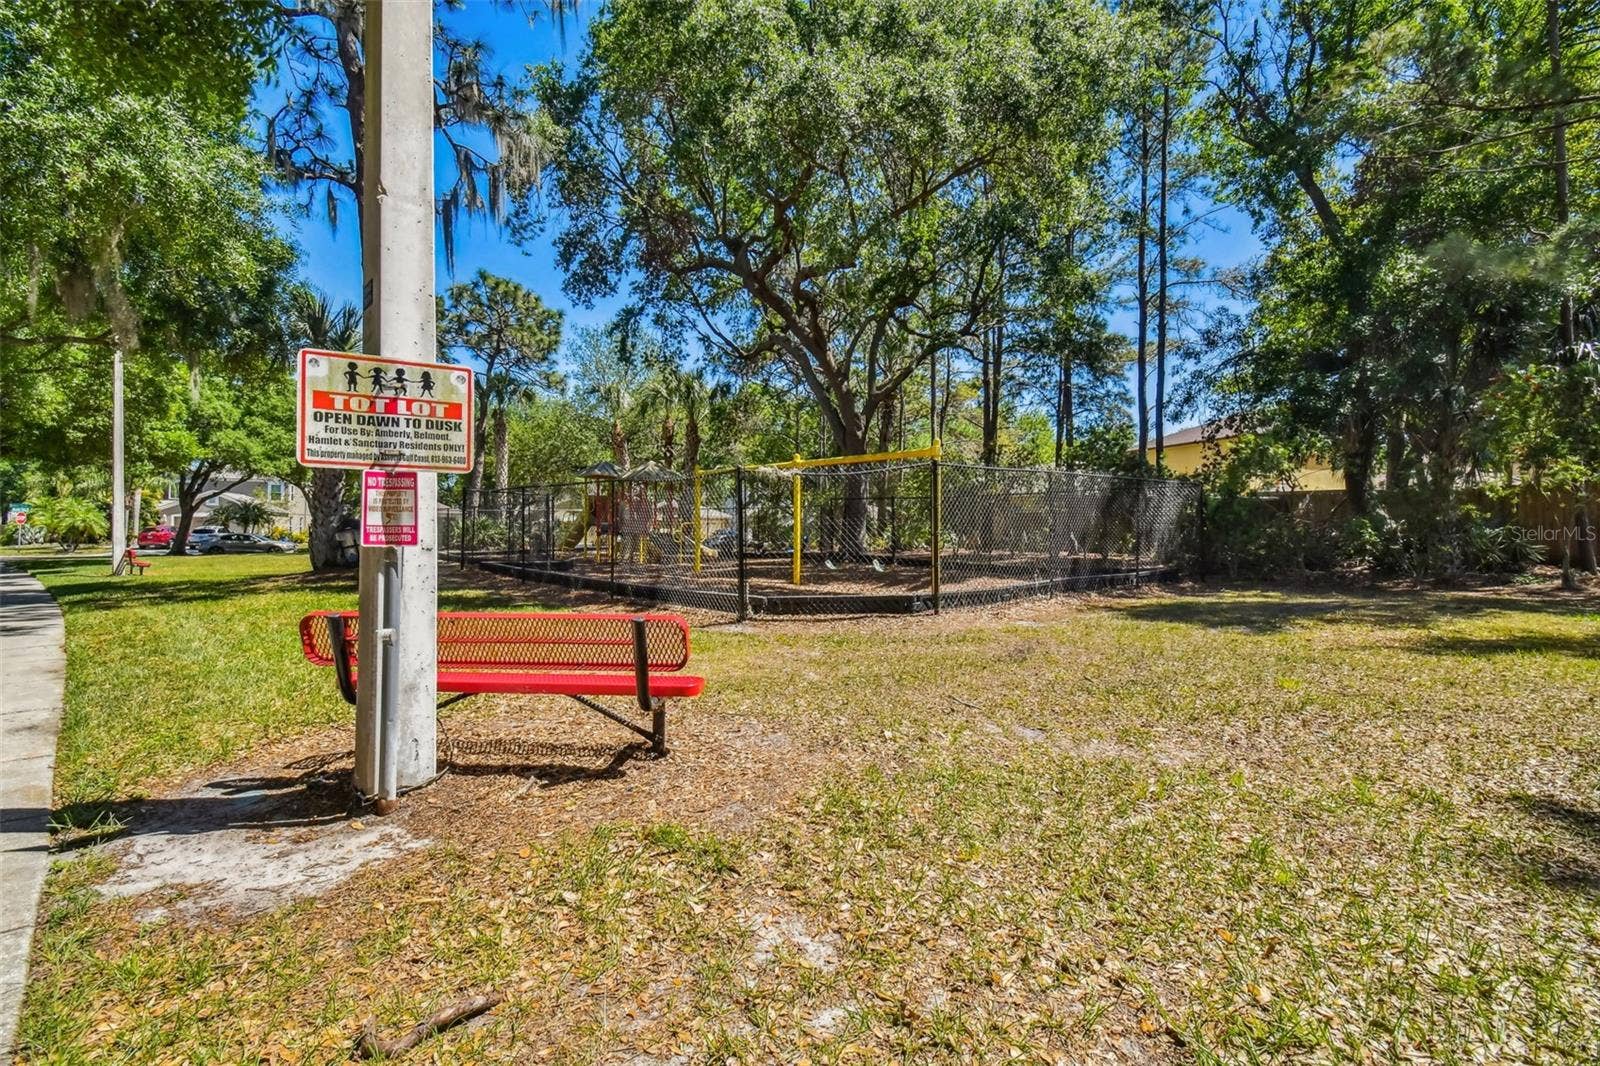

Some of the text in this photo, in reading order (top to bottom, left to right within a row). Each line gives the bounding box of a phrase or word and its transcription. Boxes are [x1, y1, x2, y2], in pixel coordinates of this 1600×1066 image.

[329, 395, 450, 418] TOT LOT
[313, 411, 463, 432] OPEN DAWN TO DUSK
[325, 425, 339, 434] For
[341, 426, 358, 435] Use
[360, 428, 374, 437] By:
[375, 429, 413, 440] Amberly,
[308, 435, 465, 453] Hamlet & Sanctuary Residents ONLY!
[306, 448, 319, 457] This
[320, 450, 346, 459] property
[346, 452, 373, 461] managed
[367, 477, 415, 487] NO TRESPASSING
[366, 526, 415, 534] TRESPASSERS WILL
